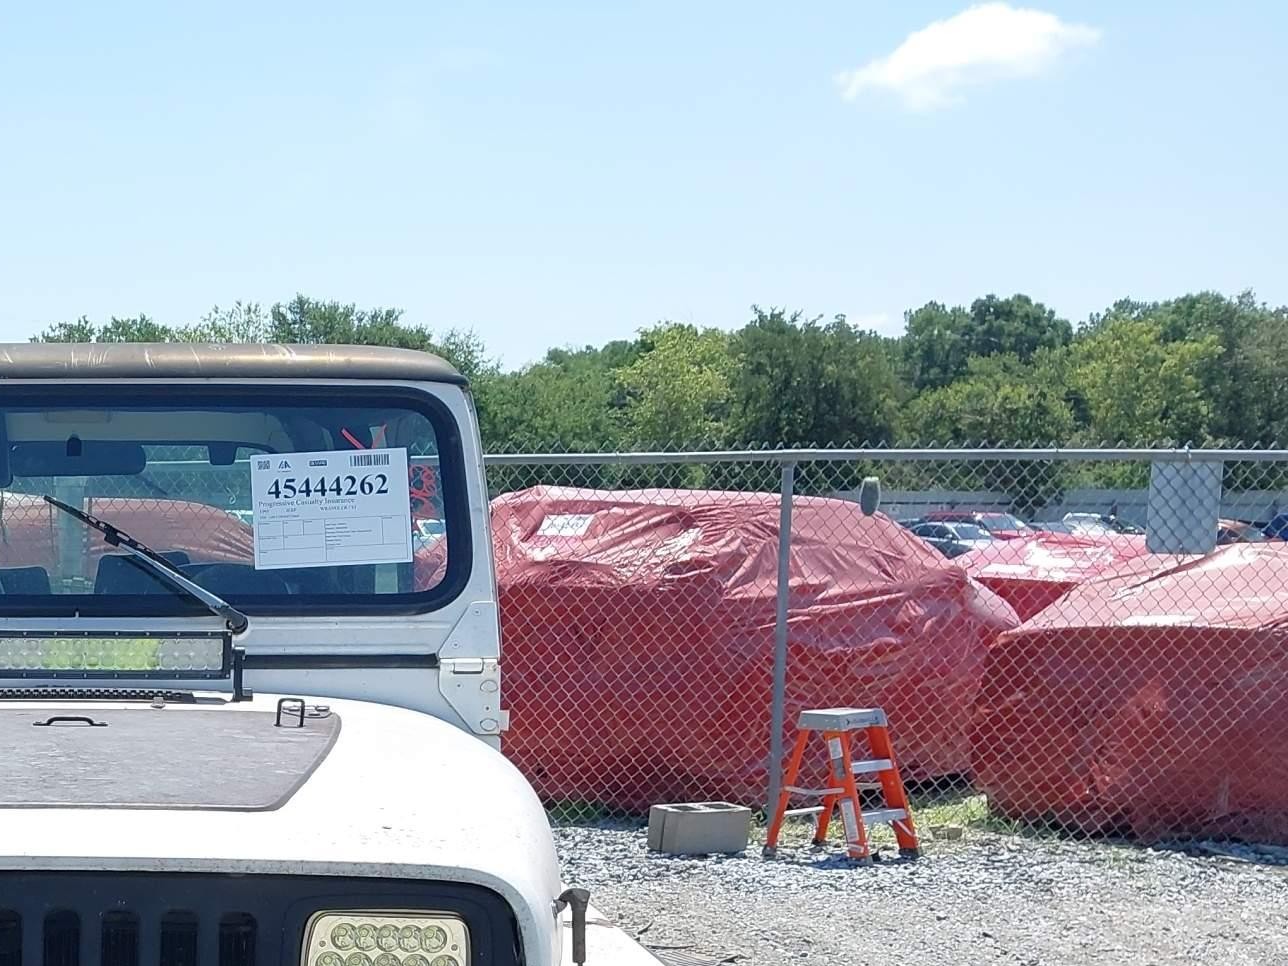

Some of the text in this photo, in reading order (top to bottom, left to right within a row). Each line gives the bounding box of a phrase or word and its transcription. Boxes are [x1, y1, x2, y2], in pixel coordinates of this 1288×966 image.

[268, 474, 389, 499] 45444262
[258, 500, 295, 508] Progressive
[296, 498, 323, 506] Casualty
